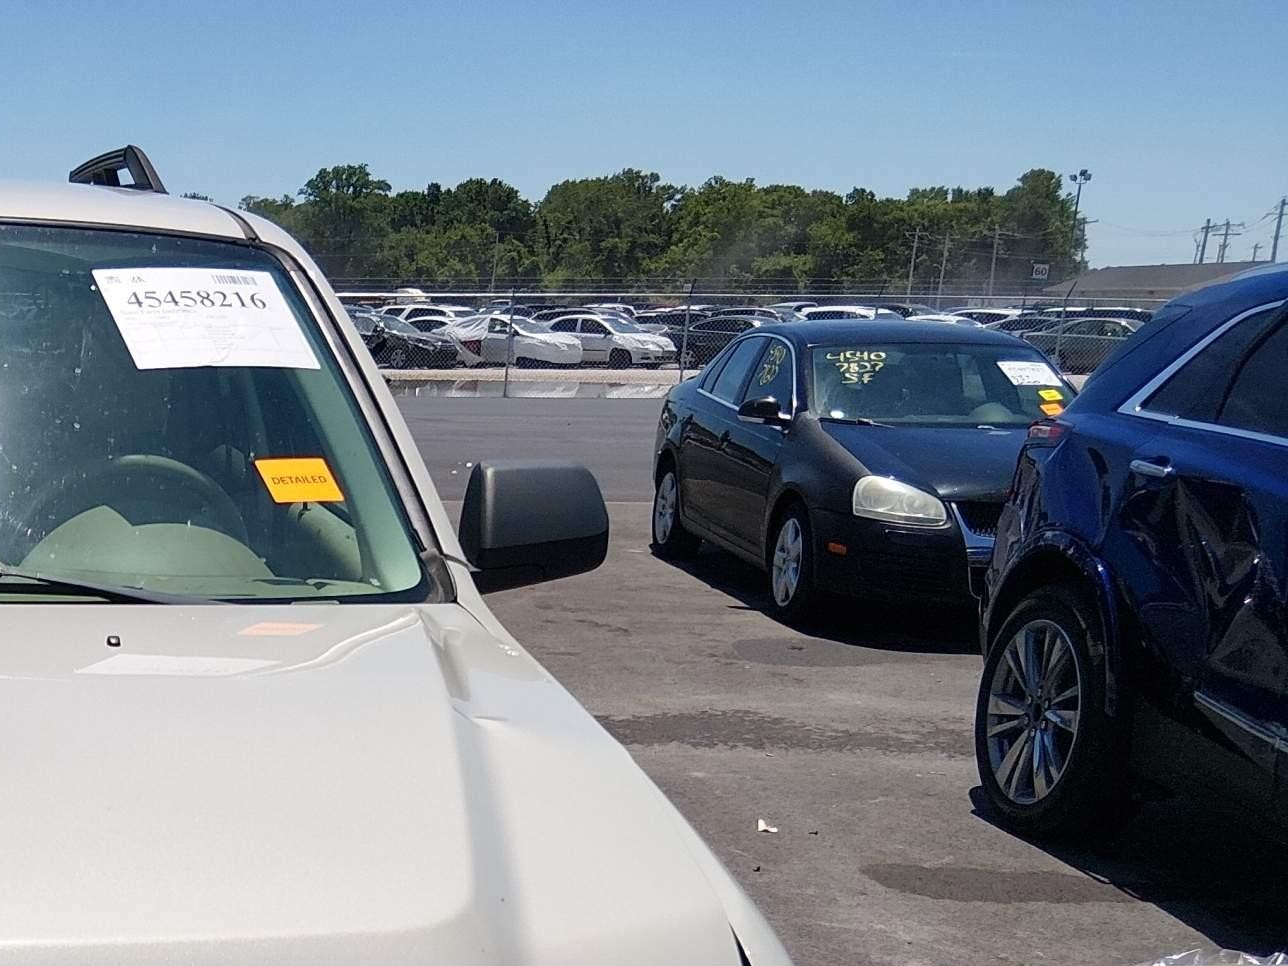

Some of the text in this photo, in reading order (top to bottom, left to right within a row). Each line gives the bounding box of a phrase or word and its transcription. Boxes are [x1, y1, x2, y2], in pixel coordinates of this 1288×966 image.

[1034, 266, 1048, 276] 60
[127, 289, 267, 310] 45458216
[826, 350, 887, 362] 4540
[835, 362, 884, 373] 7827
[271, 475, 327, 485] DETAILED
